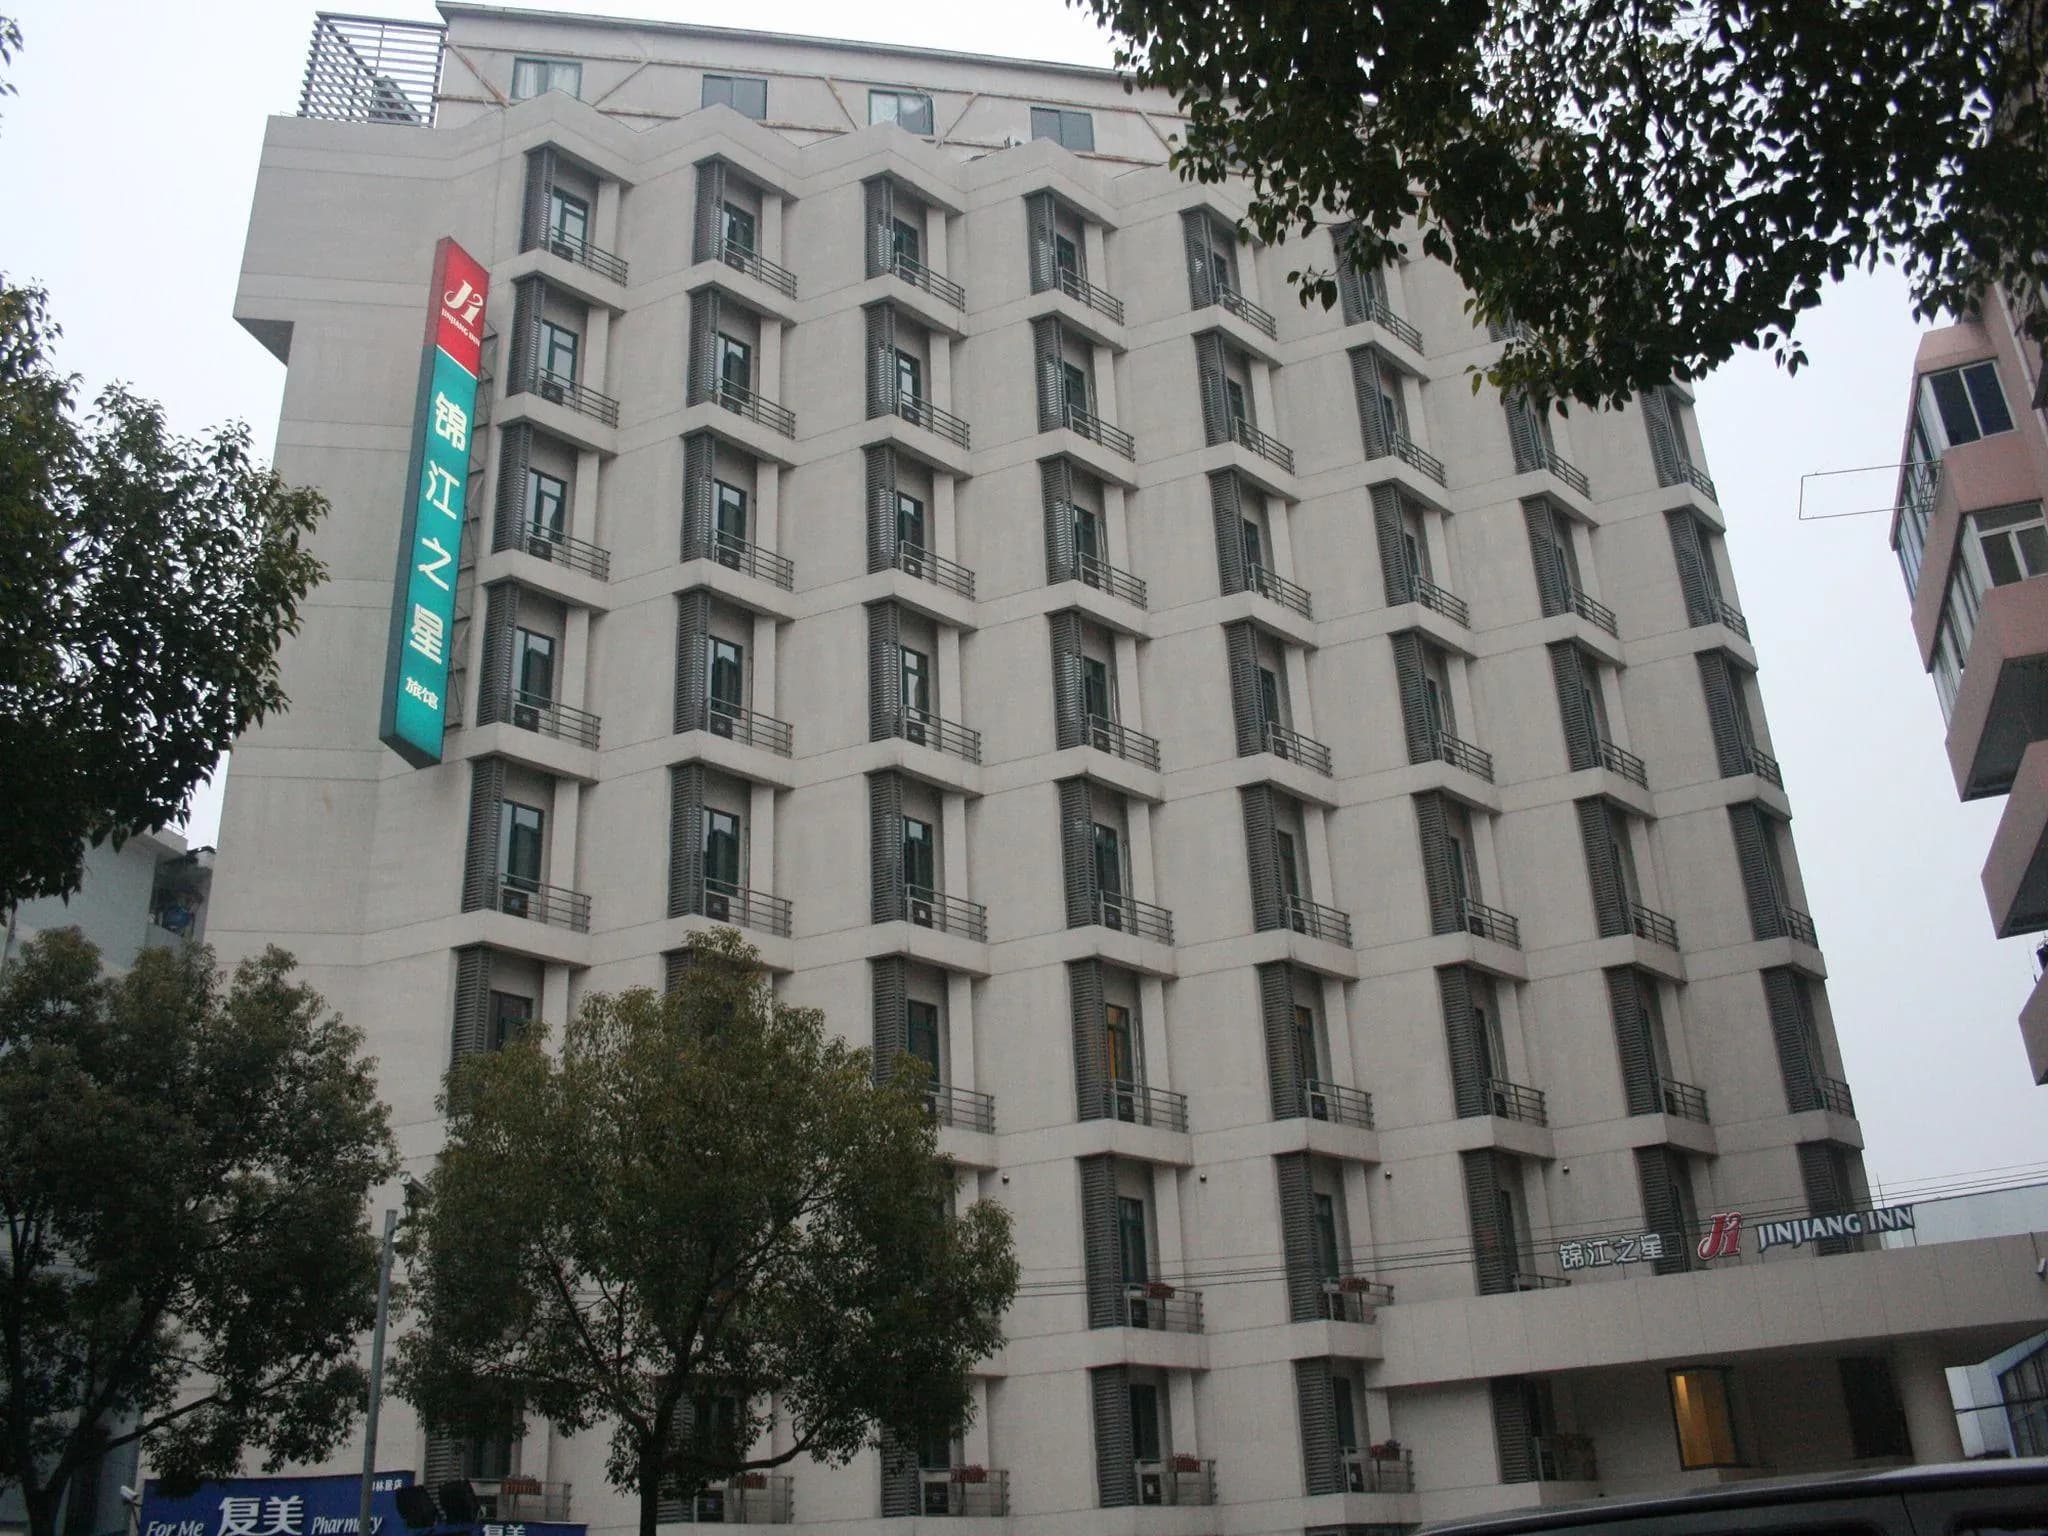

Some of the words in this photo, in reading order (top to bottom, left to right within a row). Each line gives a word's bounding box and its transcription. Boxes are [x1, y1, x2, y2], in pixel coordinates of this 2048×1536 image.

[441, 307, 469, 336] JINJIANG
[469, 331, 481, 348] INN
[409, 391, 467, 665] 锦江之星
[406, 676, 439, 710] 旅馆
[1757, 1213, 1862, 1252] JINJIANG
[1867, 1206, 1914, 1232] INN
[1559, 1233, 1665, 1270] 锦江之星
[145, 1520, 177, 1536] For
[177, 1520, 205, 1536] Me
[217, 1495, 304, 1536] 复美
[311, 1516, 383, 1535] Pharmy
